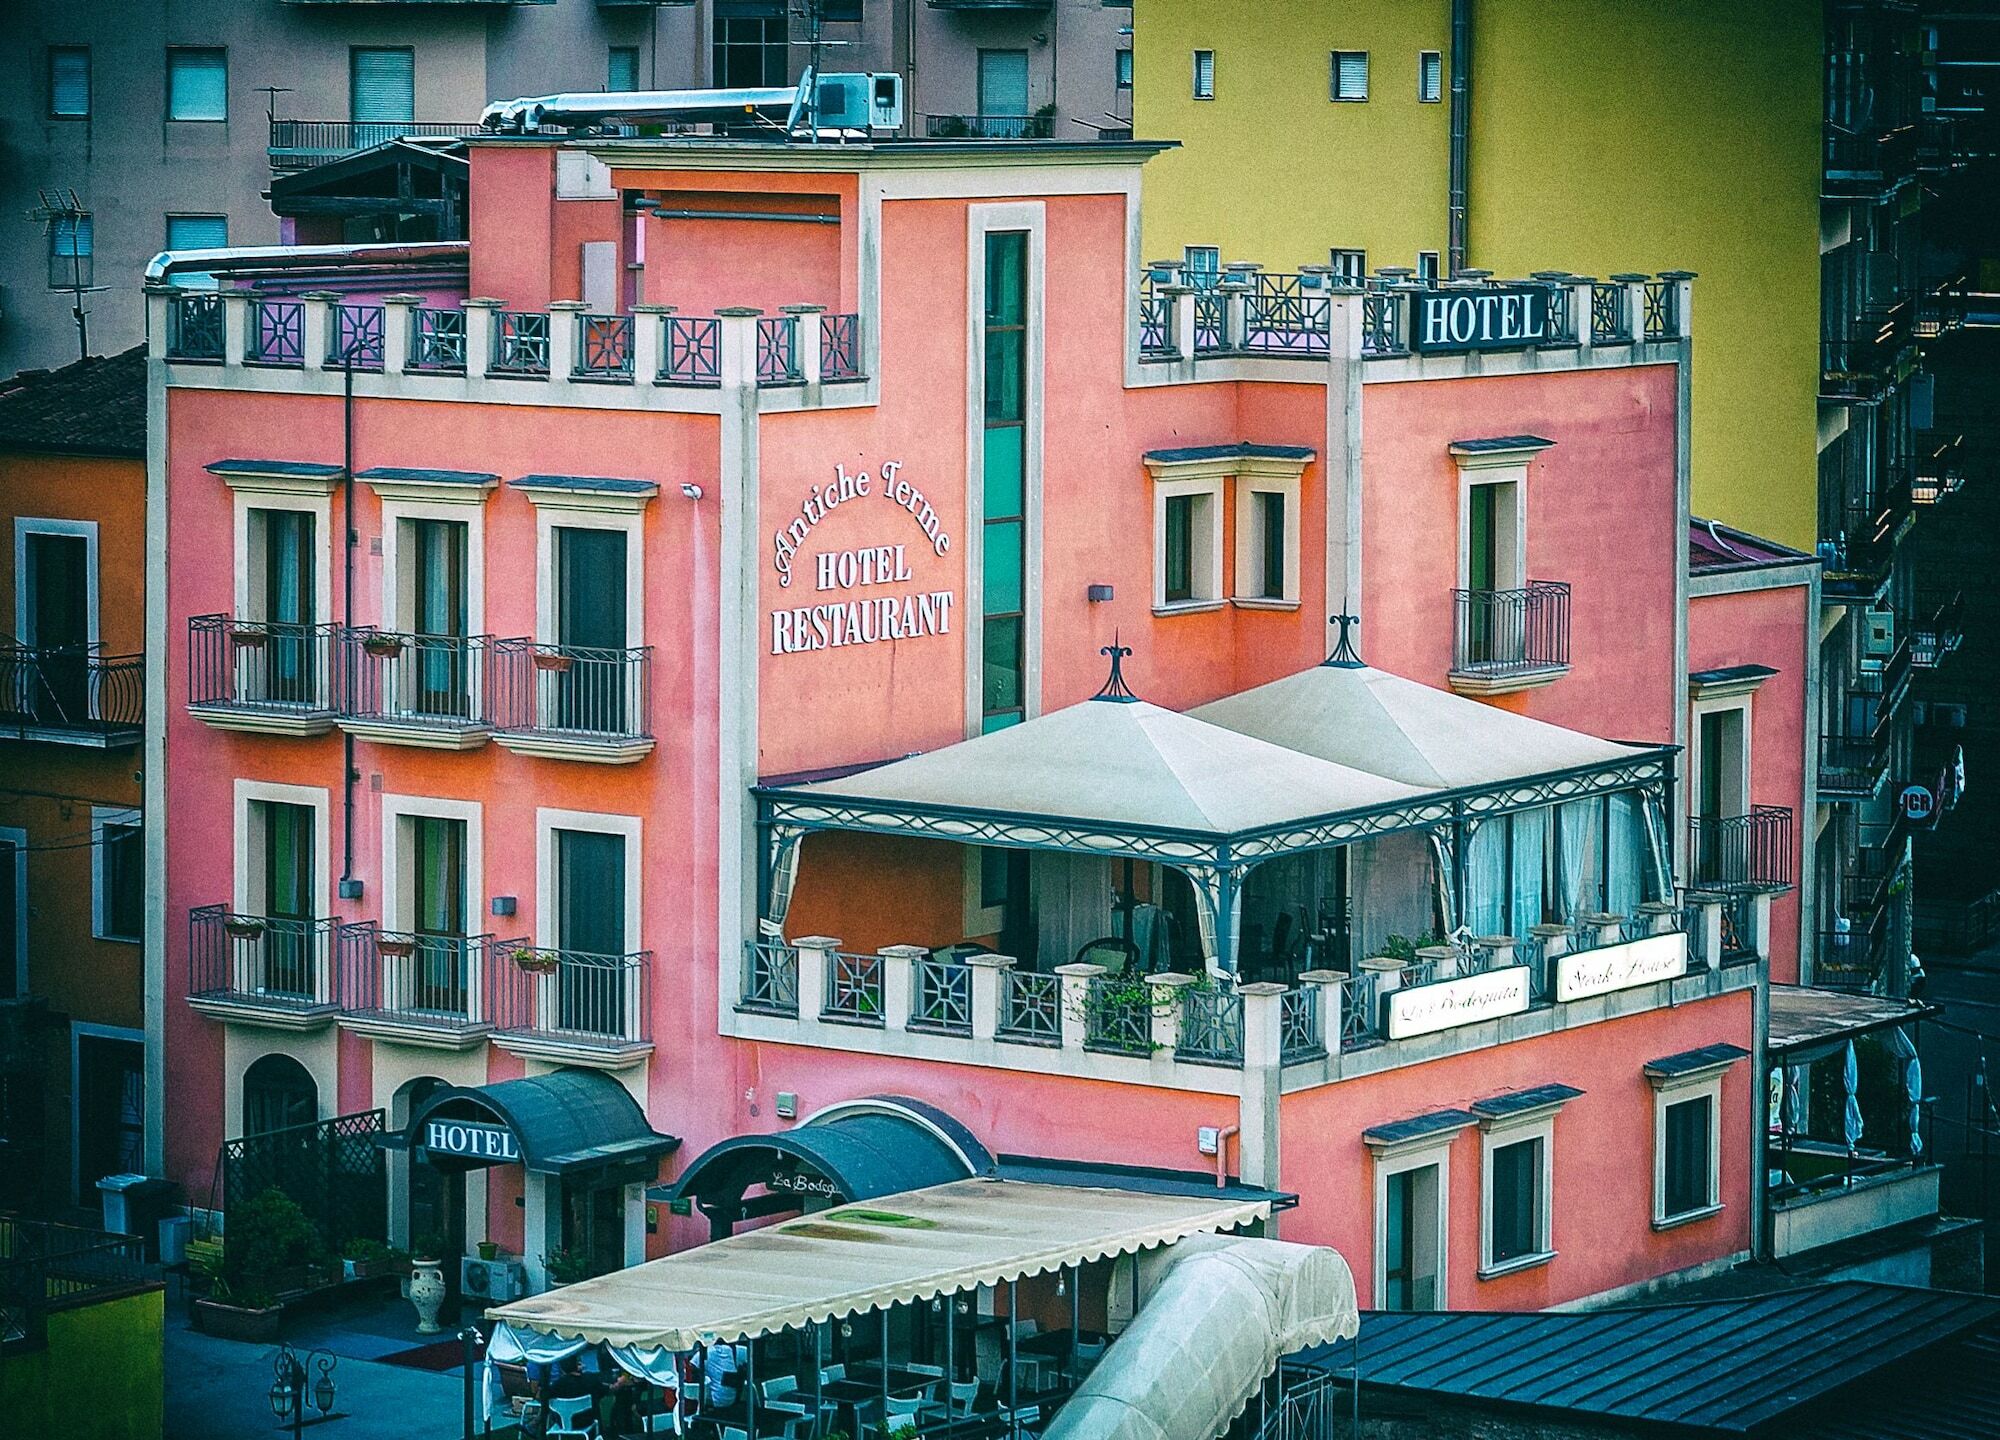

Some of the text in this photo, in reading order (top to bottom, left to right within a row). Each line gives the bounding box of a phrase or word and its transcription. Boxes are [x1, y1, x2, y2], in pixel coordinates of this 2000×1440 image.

[1423, 294, 1544, 344] HOTEL
[774, 460, 950, 588] Antiche Terme
[816, 544, 912, 591] HOTEL
[770, 591, 954, 655] RESTAURANT
[428, 1123, 519, 1159] HOTEL
[773, 1172, 792, 1187] La
